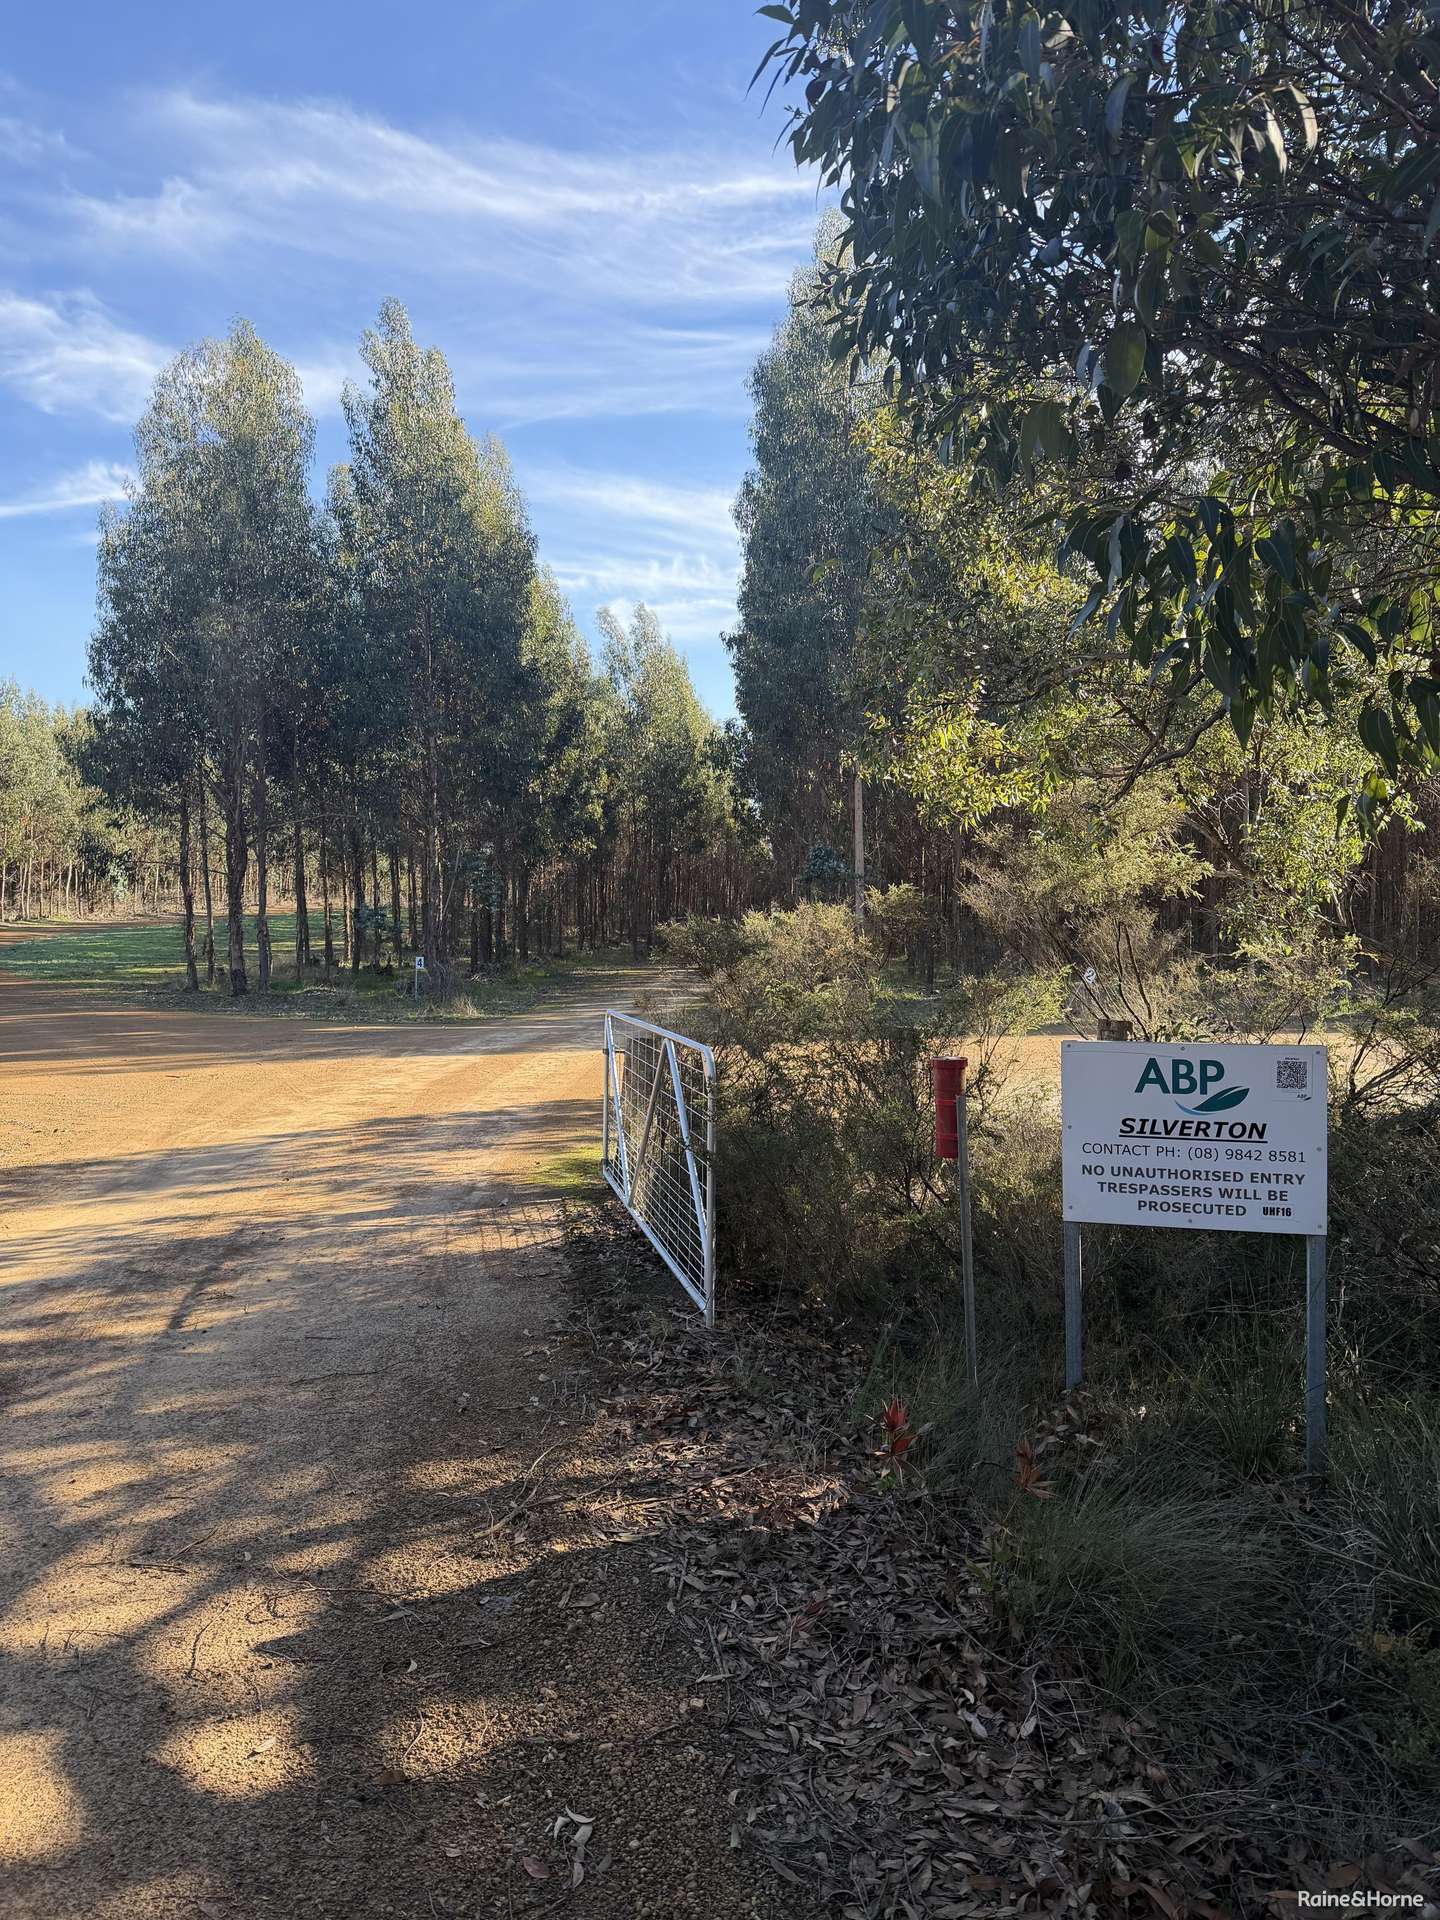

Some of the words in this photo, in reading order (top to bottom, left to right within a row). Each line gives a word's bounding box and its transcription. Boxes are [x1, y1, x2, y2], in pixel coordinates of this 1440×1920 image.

[416, 958, 423, 968] 4
[1134, 1057, 1225, 1095] ABP
[1119, 1117, 1268, 1140] SILVERTON
[1082, 1142, 1151, 1158] CONTACT
[1156, 1145, 1181, 1158] PH:
[1187, 1146, 1220, 1162] (08)
[1225, 1149, 1263, 1162] 9842
[1268, 1150, 1306, 1163] 8581
[1081, 1164, 1105, 1176] NO
[1110, 1165, 1244, 1183] UNAUTHORISED
[1250, 1172, 1306, 1185] ENTRY
[1097, 1181, 1213, 1198] TRESPASSERS
[1218, 1188, 1262, 1201] WILL
[1267, 1190, 1289, 1202] BE
[1137, 1200, 1247, 1217] PROSECUTED
[1262, 1206, 1292, 1217] UHF16
